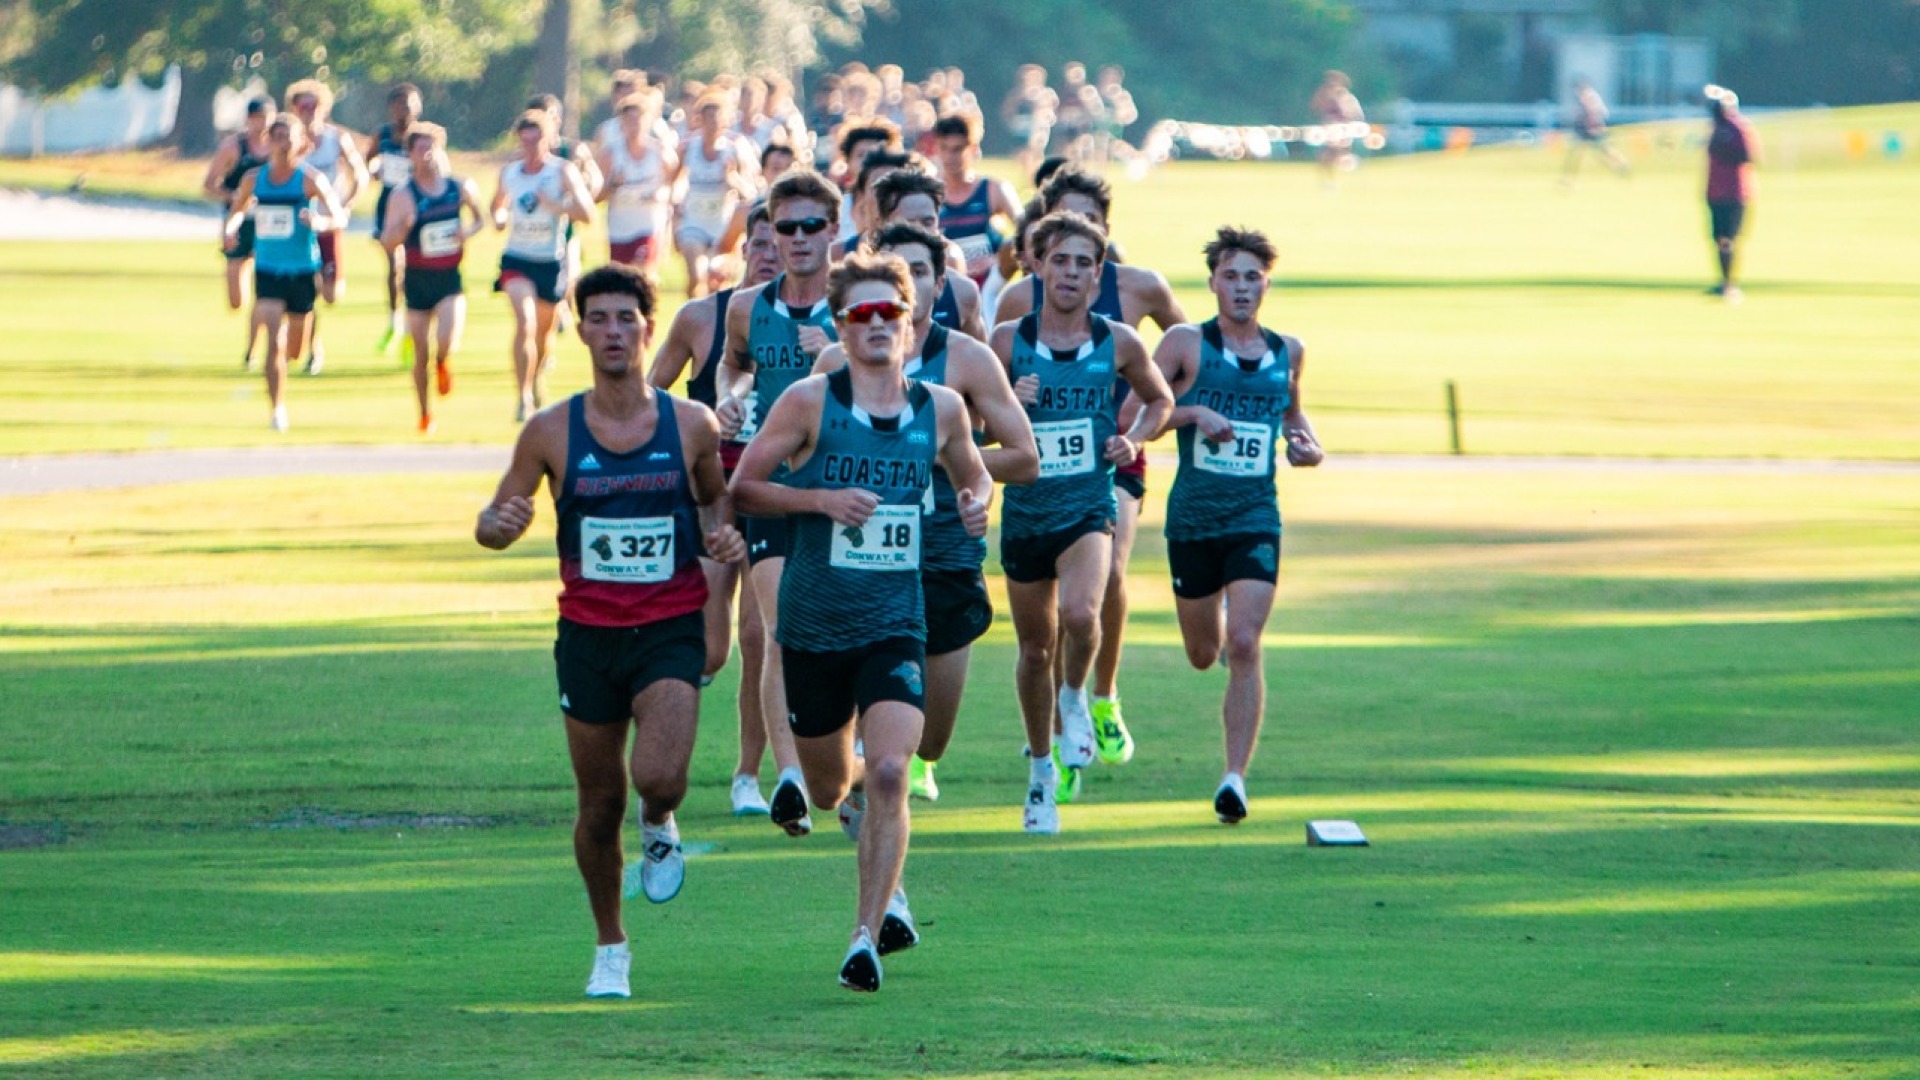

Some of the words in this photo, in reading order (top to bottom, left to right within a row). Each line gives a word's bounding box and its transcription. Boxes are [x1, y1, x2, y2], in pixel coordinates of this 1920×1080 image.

[1058, 435, 1084, 458] 19
[1234, 437, 1261, 458] 16
[620, 533, 672, 558] 327
[882, 523, 911, 548] 18
